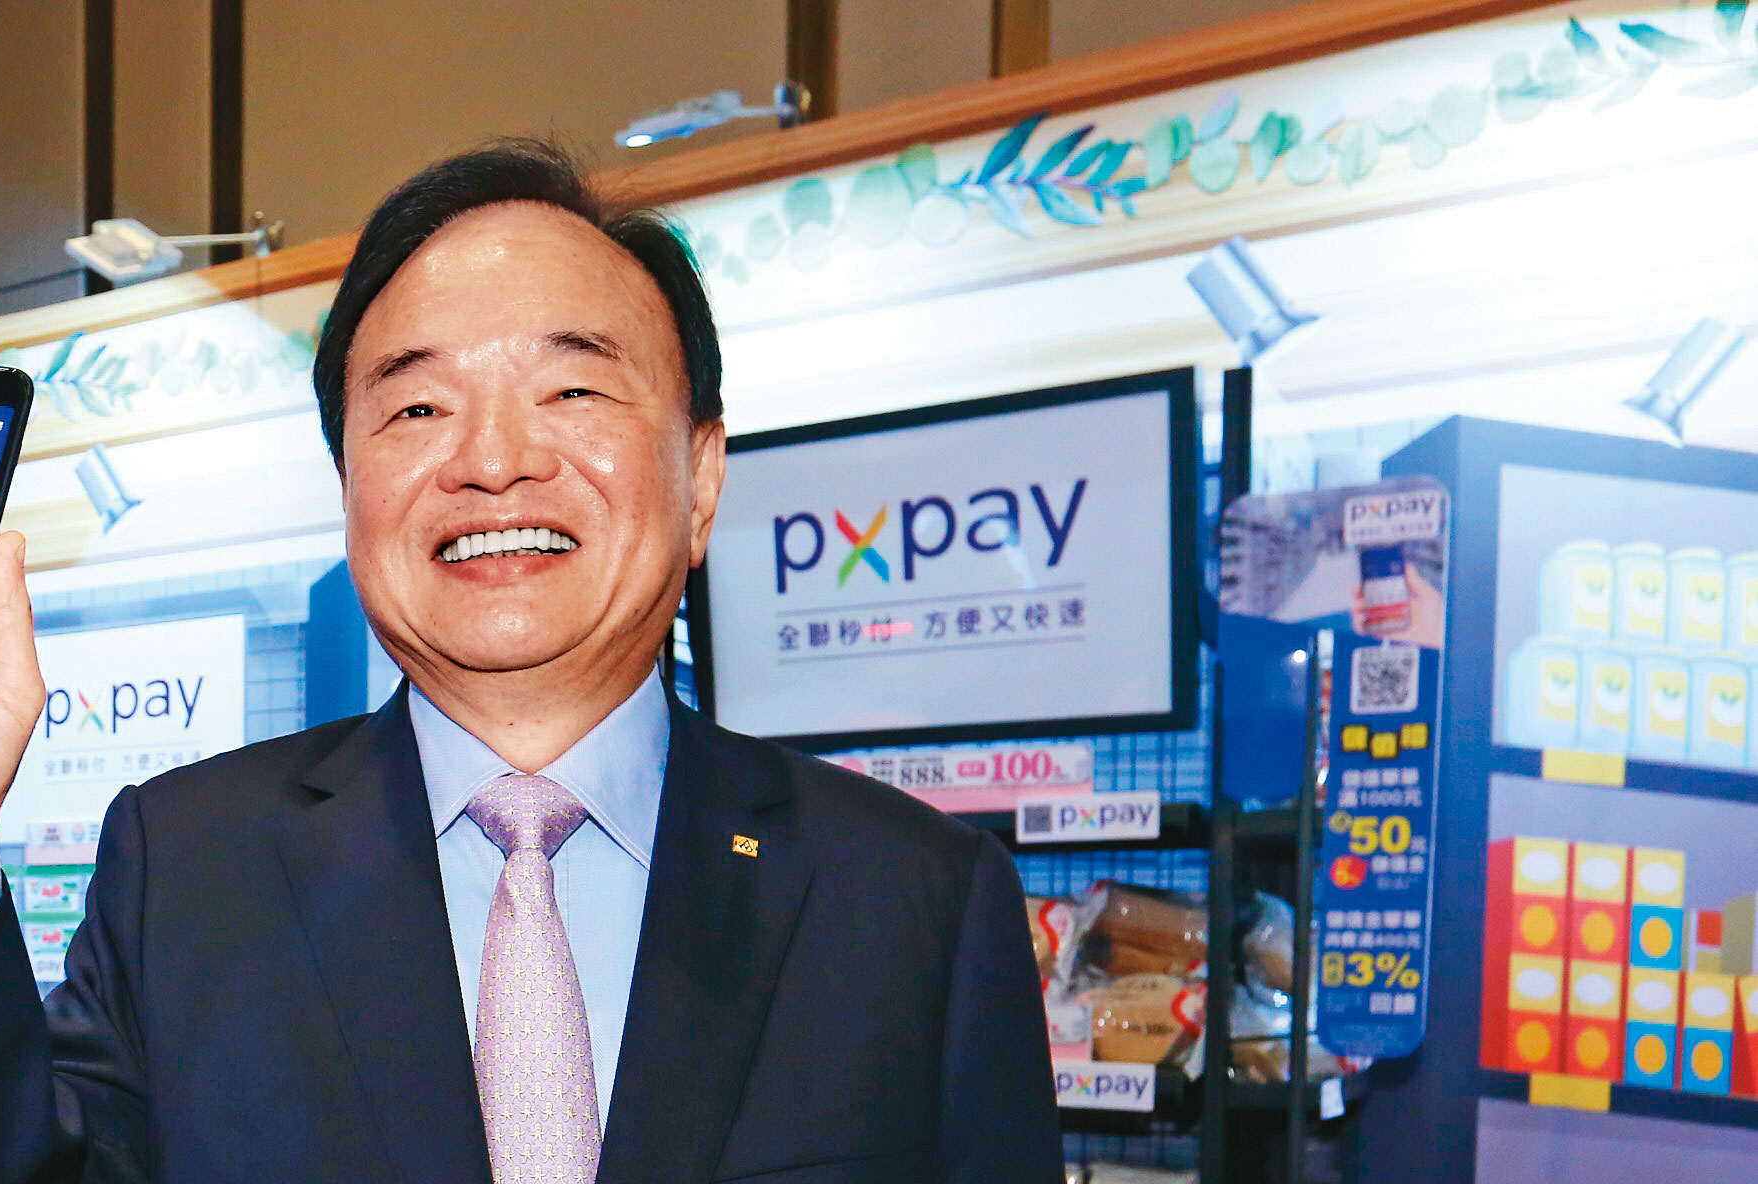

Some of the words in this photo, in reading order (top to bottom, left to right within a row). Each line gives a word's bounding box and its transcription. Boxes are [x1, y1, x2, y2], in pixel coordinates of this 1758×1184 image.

[1351, 496, 1435, 522] pxpay
[774, 478, 1088, 594] pxpay
[778, 614, 893, 652] 全聯秒付
[924, 598, 1085, 639] 方便又快速
[47, 676, 203, 738] pxpay
[991, 750, 1051, 783] 100
[1060, 802, 1154, 829] pxpay
[1057, 1072, 1149, 1101] pxpay
